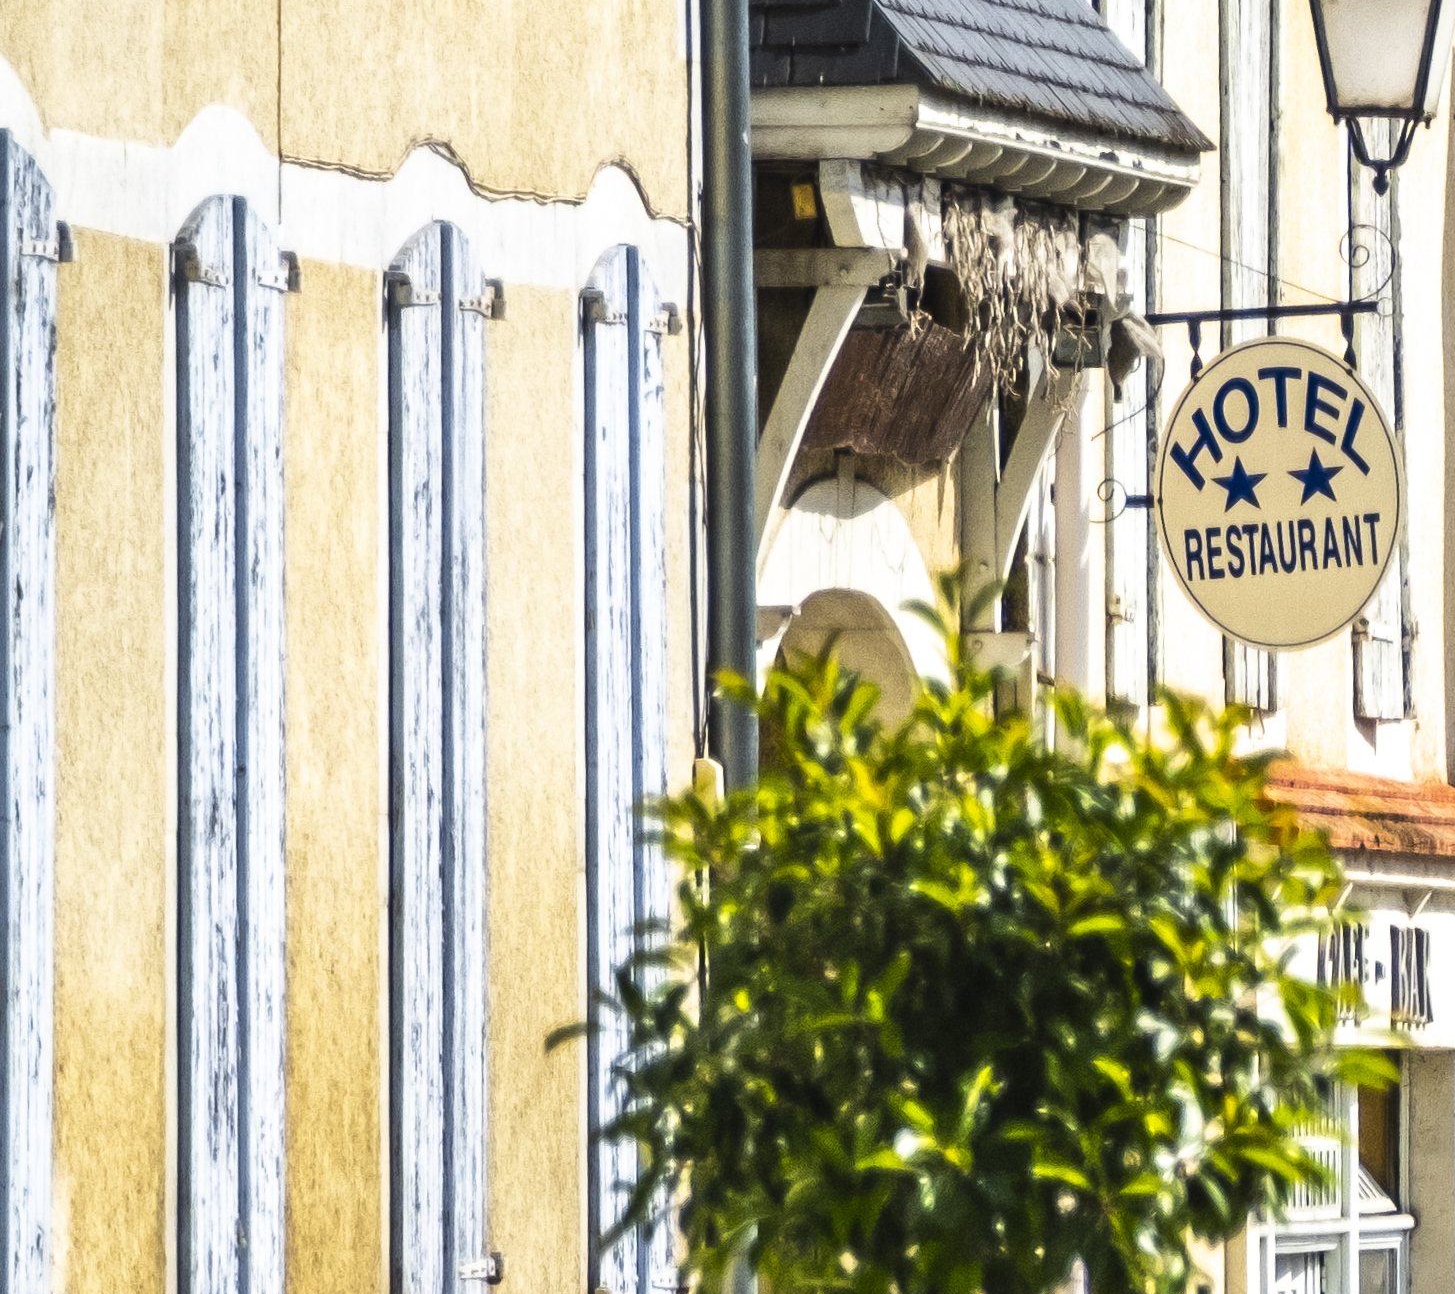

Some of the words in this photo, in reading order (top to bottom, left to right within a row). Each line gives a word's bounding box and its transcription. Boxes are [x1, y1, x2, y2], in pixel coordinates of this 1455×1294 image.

[1169, 365, 1372, 492] HOTEL
[1183, 511, 1383, 583] RESTAURANT
[1389, 924, 1435, 1024] BAR
